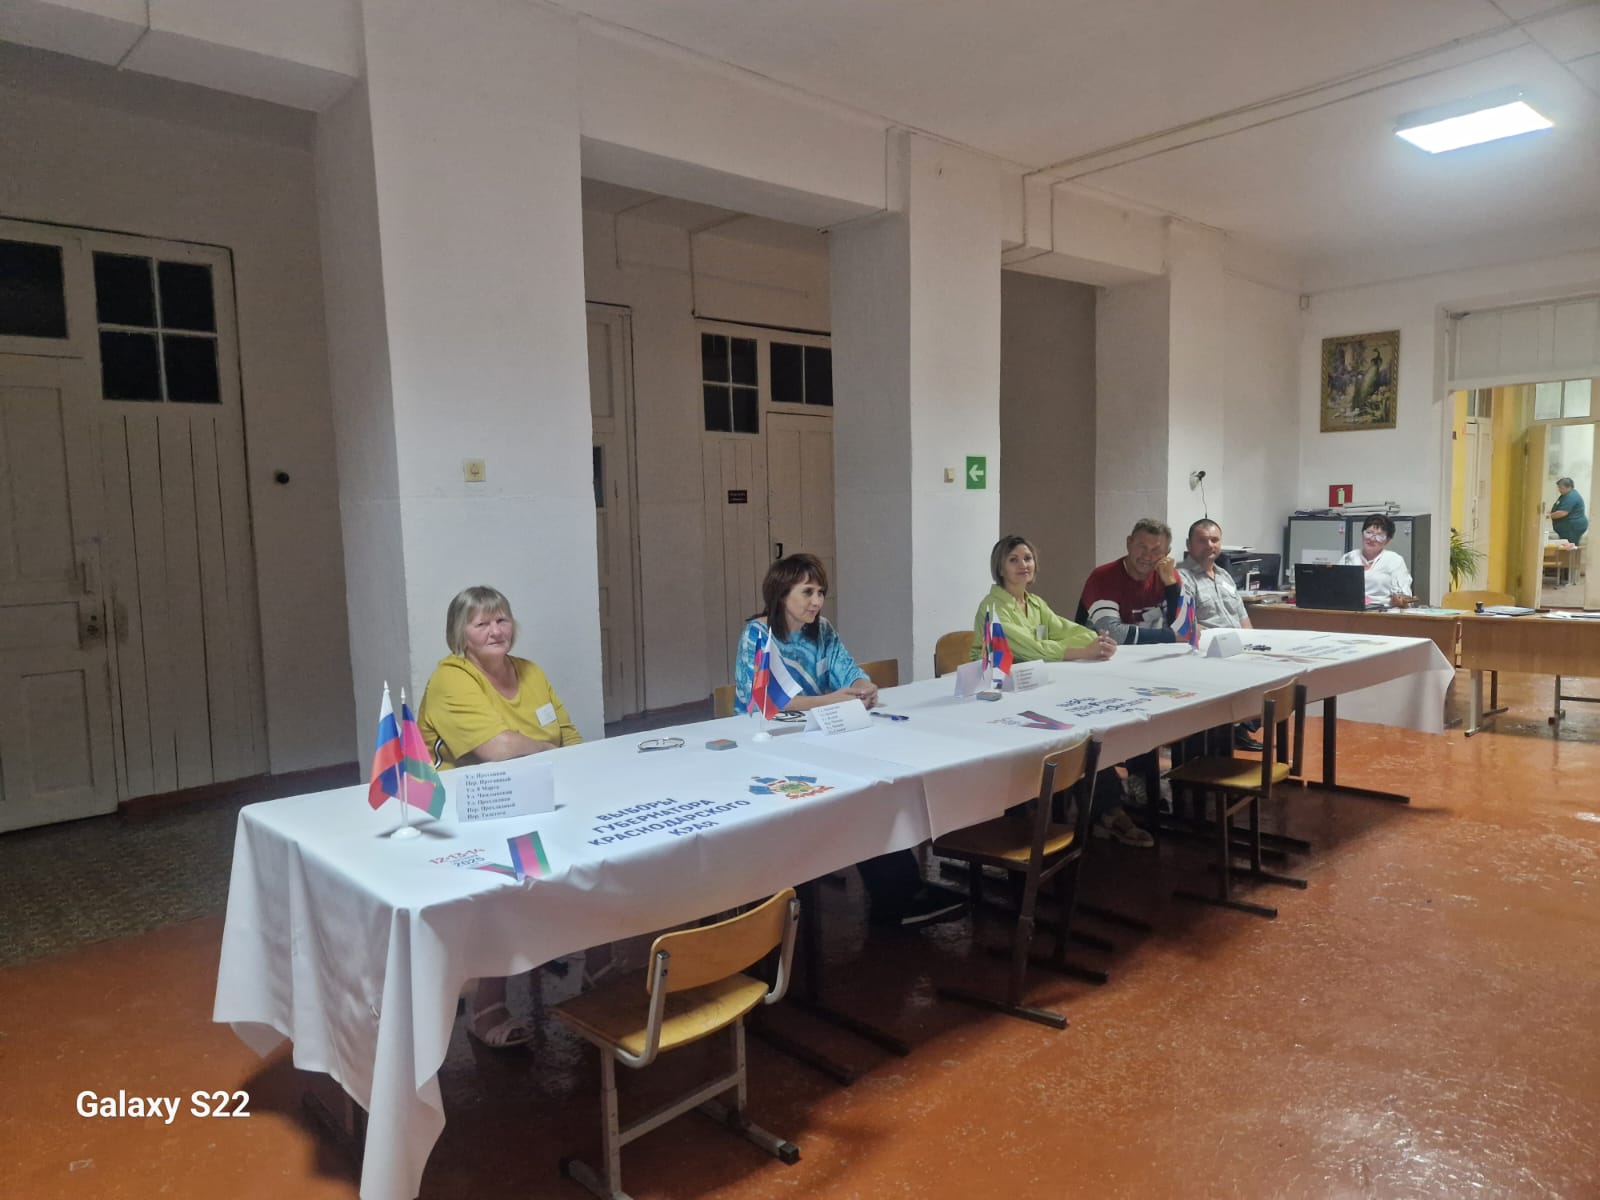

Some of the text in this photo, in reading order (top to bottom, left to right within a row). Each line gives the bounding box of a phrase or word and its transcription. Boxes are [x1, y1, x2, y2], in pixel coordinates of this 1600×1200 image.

[587, 800, 751, 846] КРАСНОДАРСКОГО
[592, 799, 715, 834] ГУБЕРНАТОРА
[596, 798, 678, 821] ВЫБОРЫ
[668, 820, 719, 836] КРАЯ
